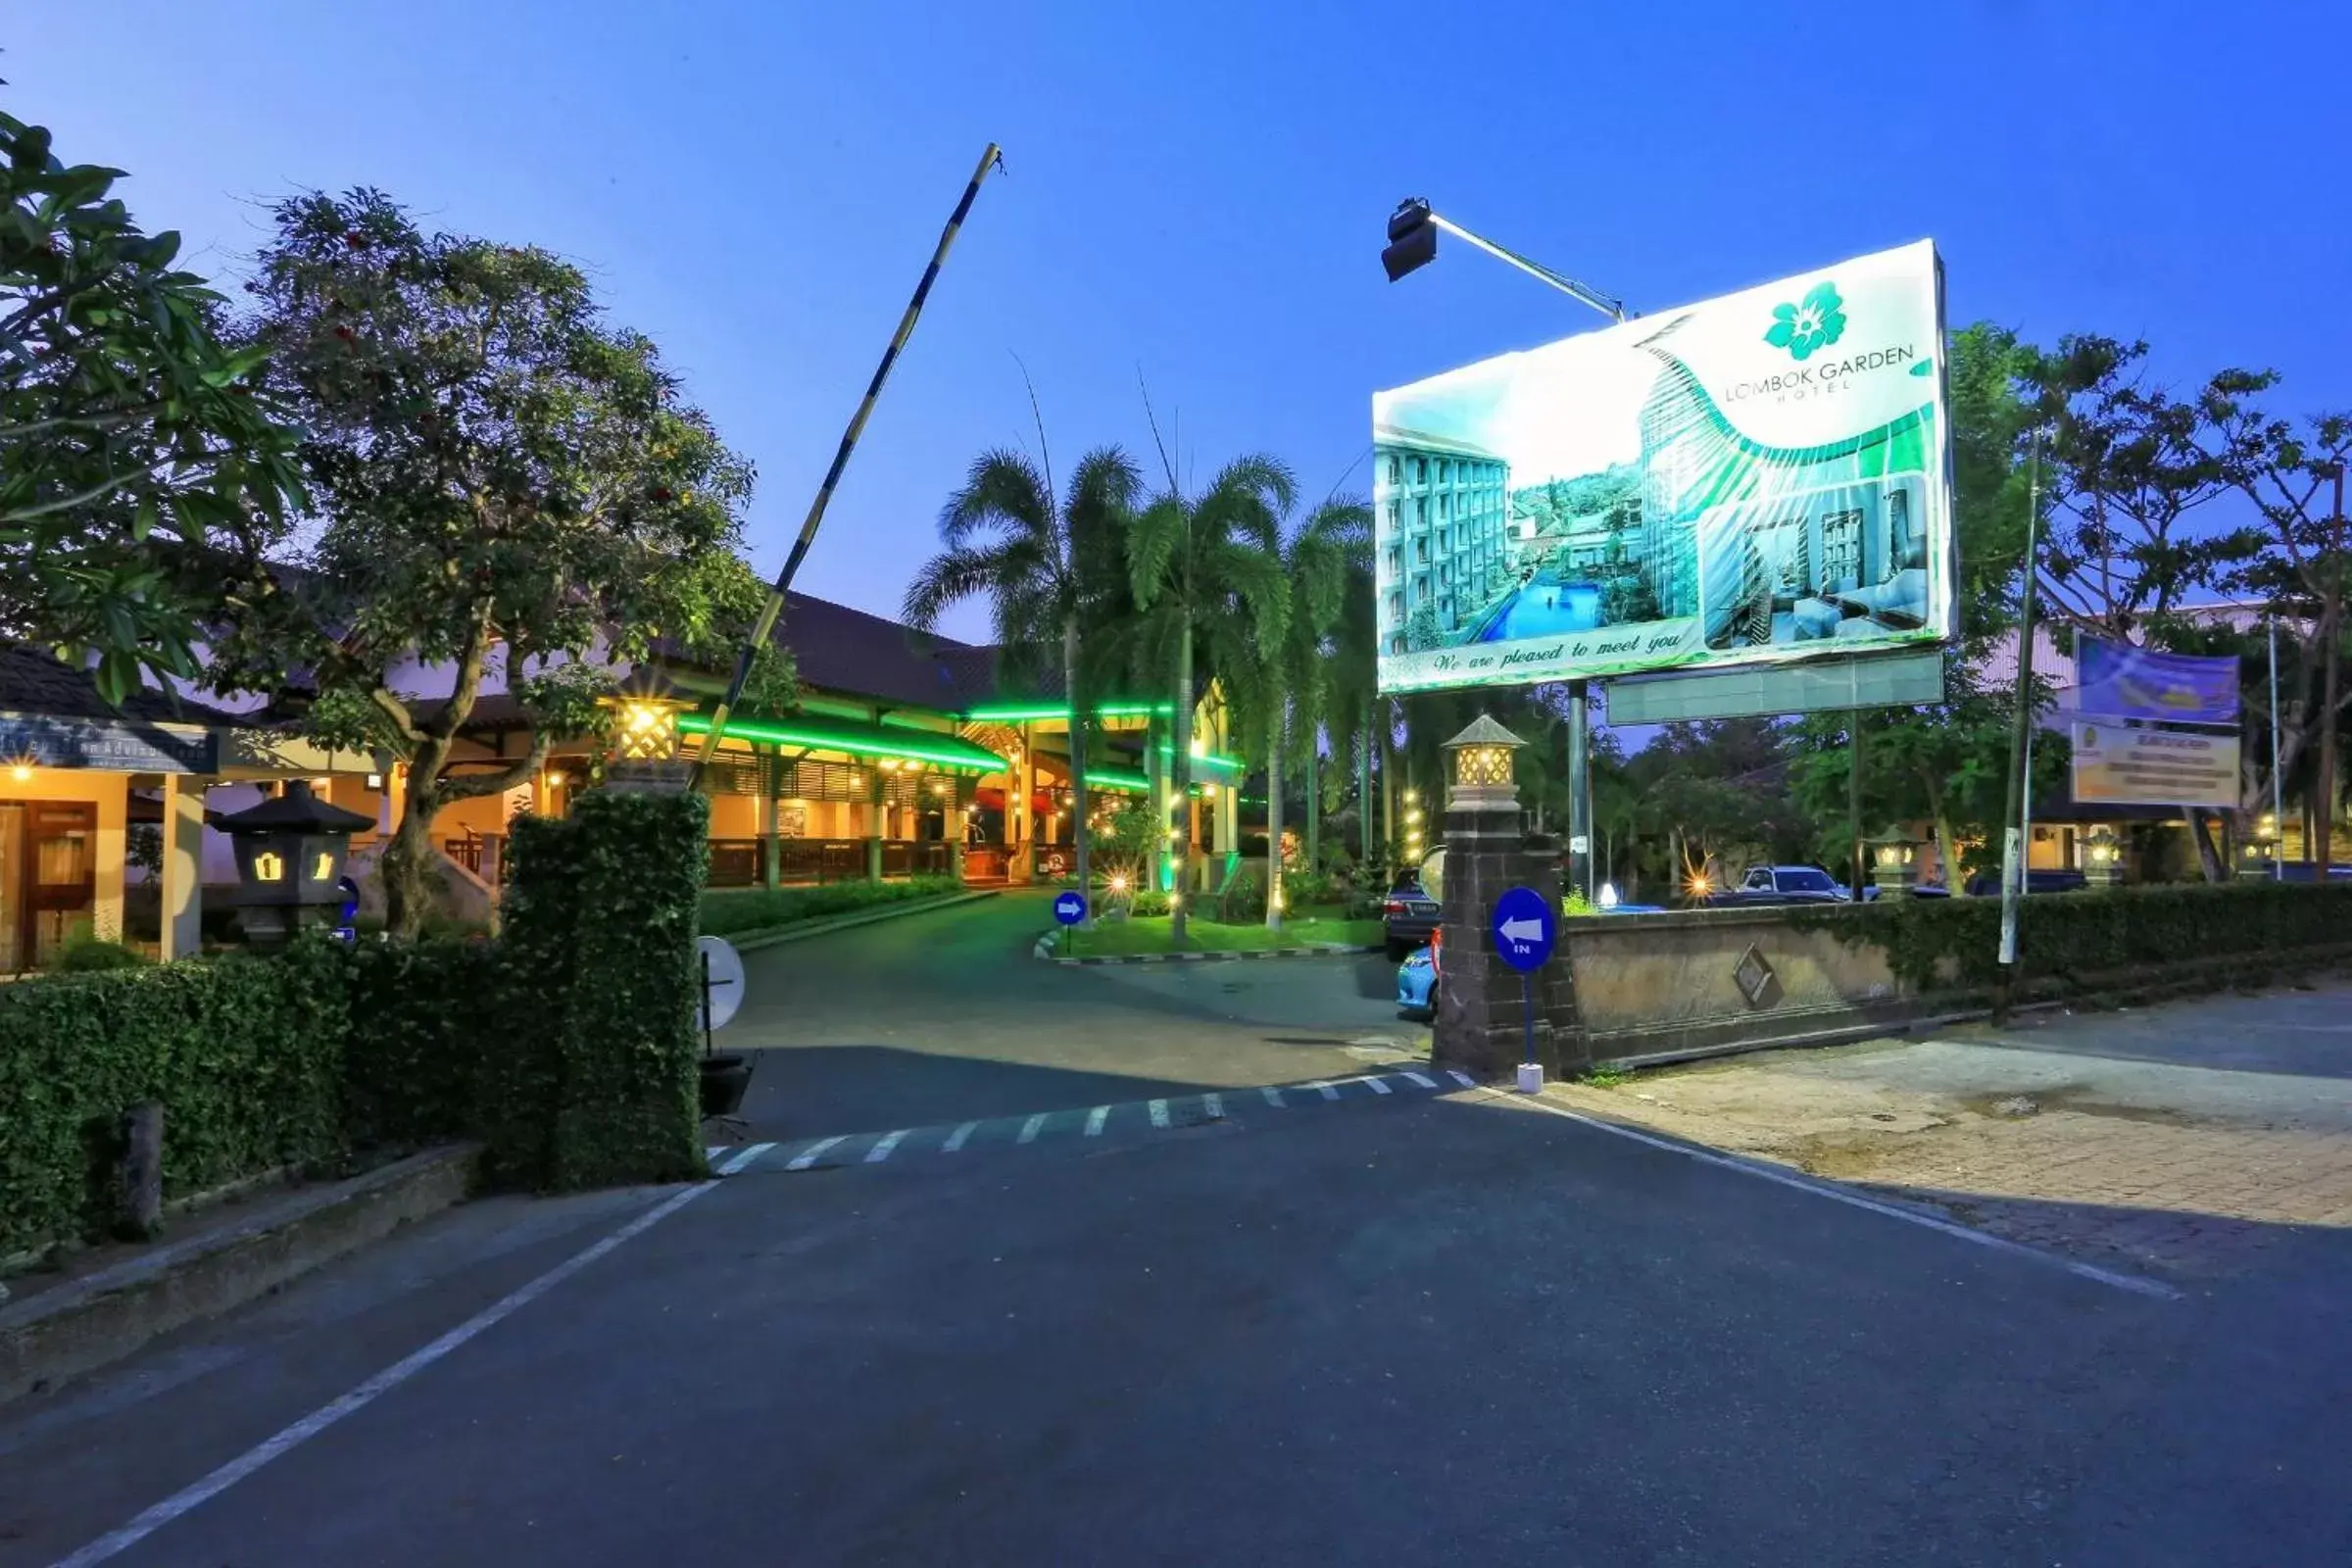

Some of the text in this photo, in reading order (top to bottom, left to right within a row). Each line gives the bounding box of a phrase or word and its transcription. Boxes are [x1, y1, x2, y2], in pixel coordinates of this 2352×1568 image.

[1725, 344, 1914, 403] LOMBOK GARDEN
[1777, 381, 1851, 404] HOTEL
[1434, 634, 1682, 672] We are pleased to meet you
[1514, 945, 1531, 955] IN
